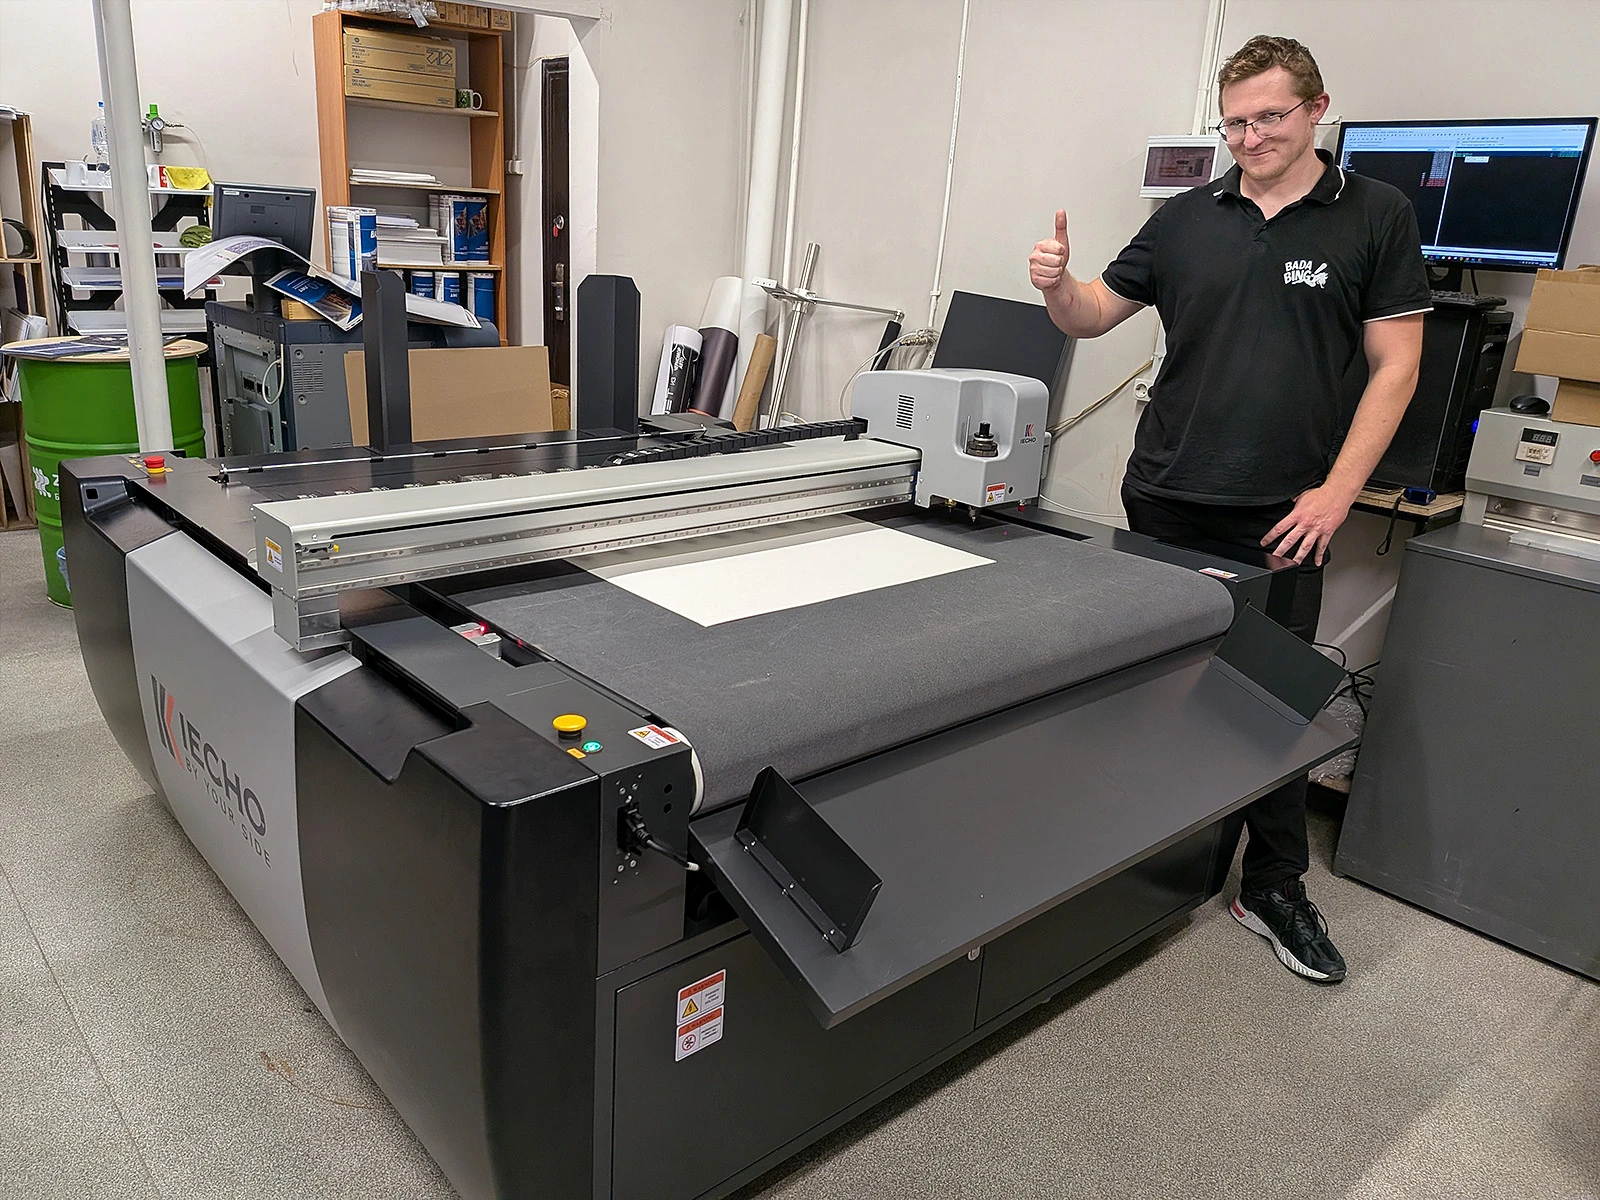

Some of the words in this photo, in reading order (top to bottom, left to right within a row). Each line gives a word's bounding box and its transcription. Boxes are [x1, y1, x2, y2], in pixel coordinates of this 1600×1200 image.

[1283, 270, 1312, 285] BING
[1285, 260, 1313, 272] BADA
[178, 711, 268, 837] IECHO
[185, 756, 199, 780] BY
[204, 778, 236, 826] YOUR
[241, 823, 273, 870] SIDE
